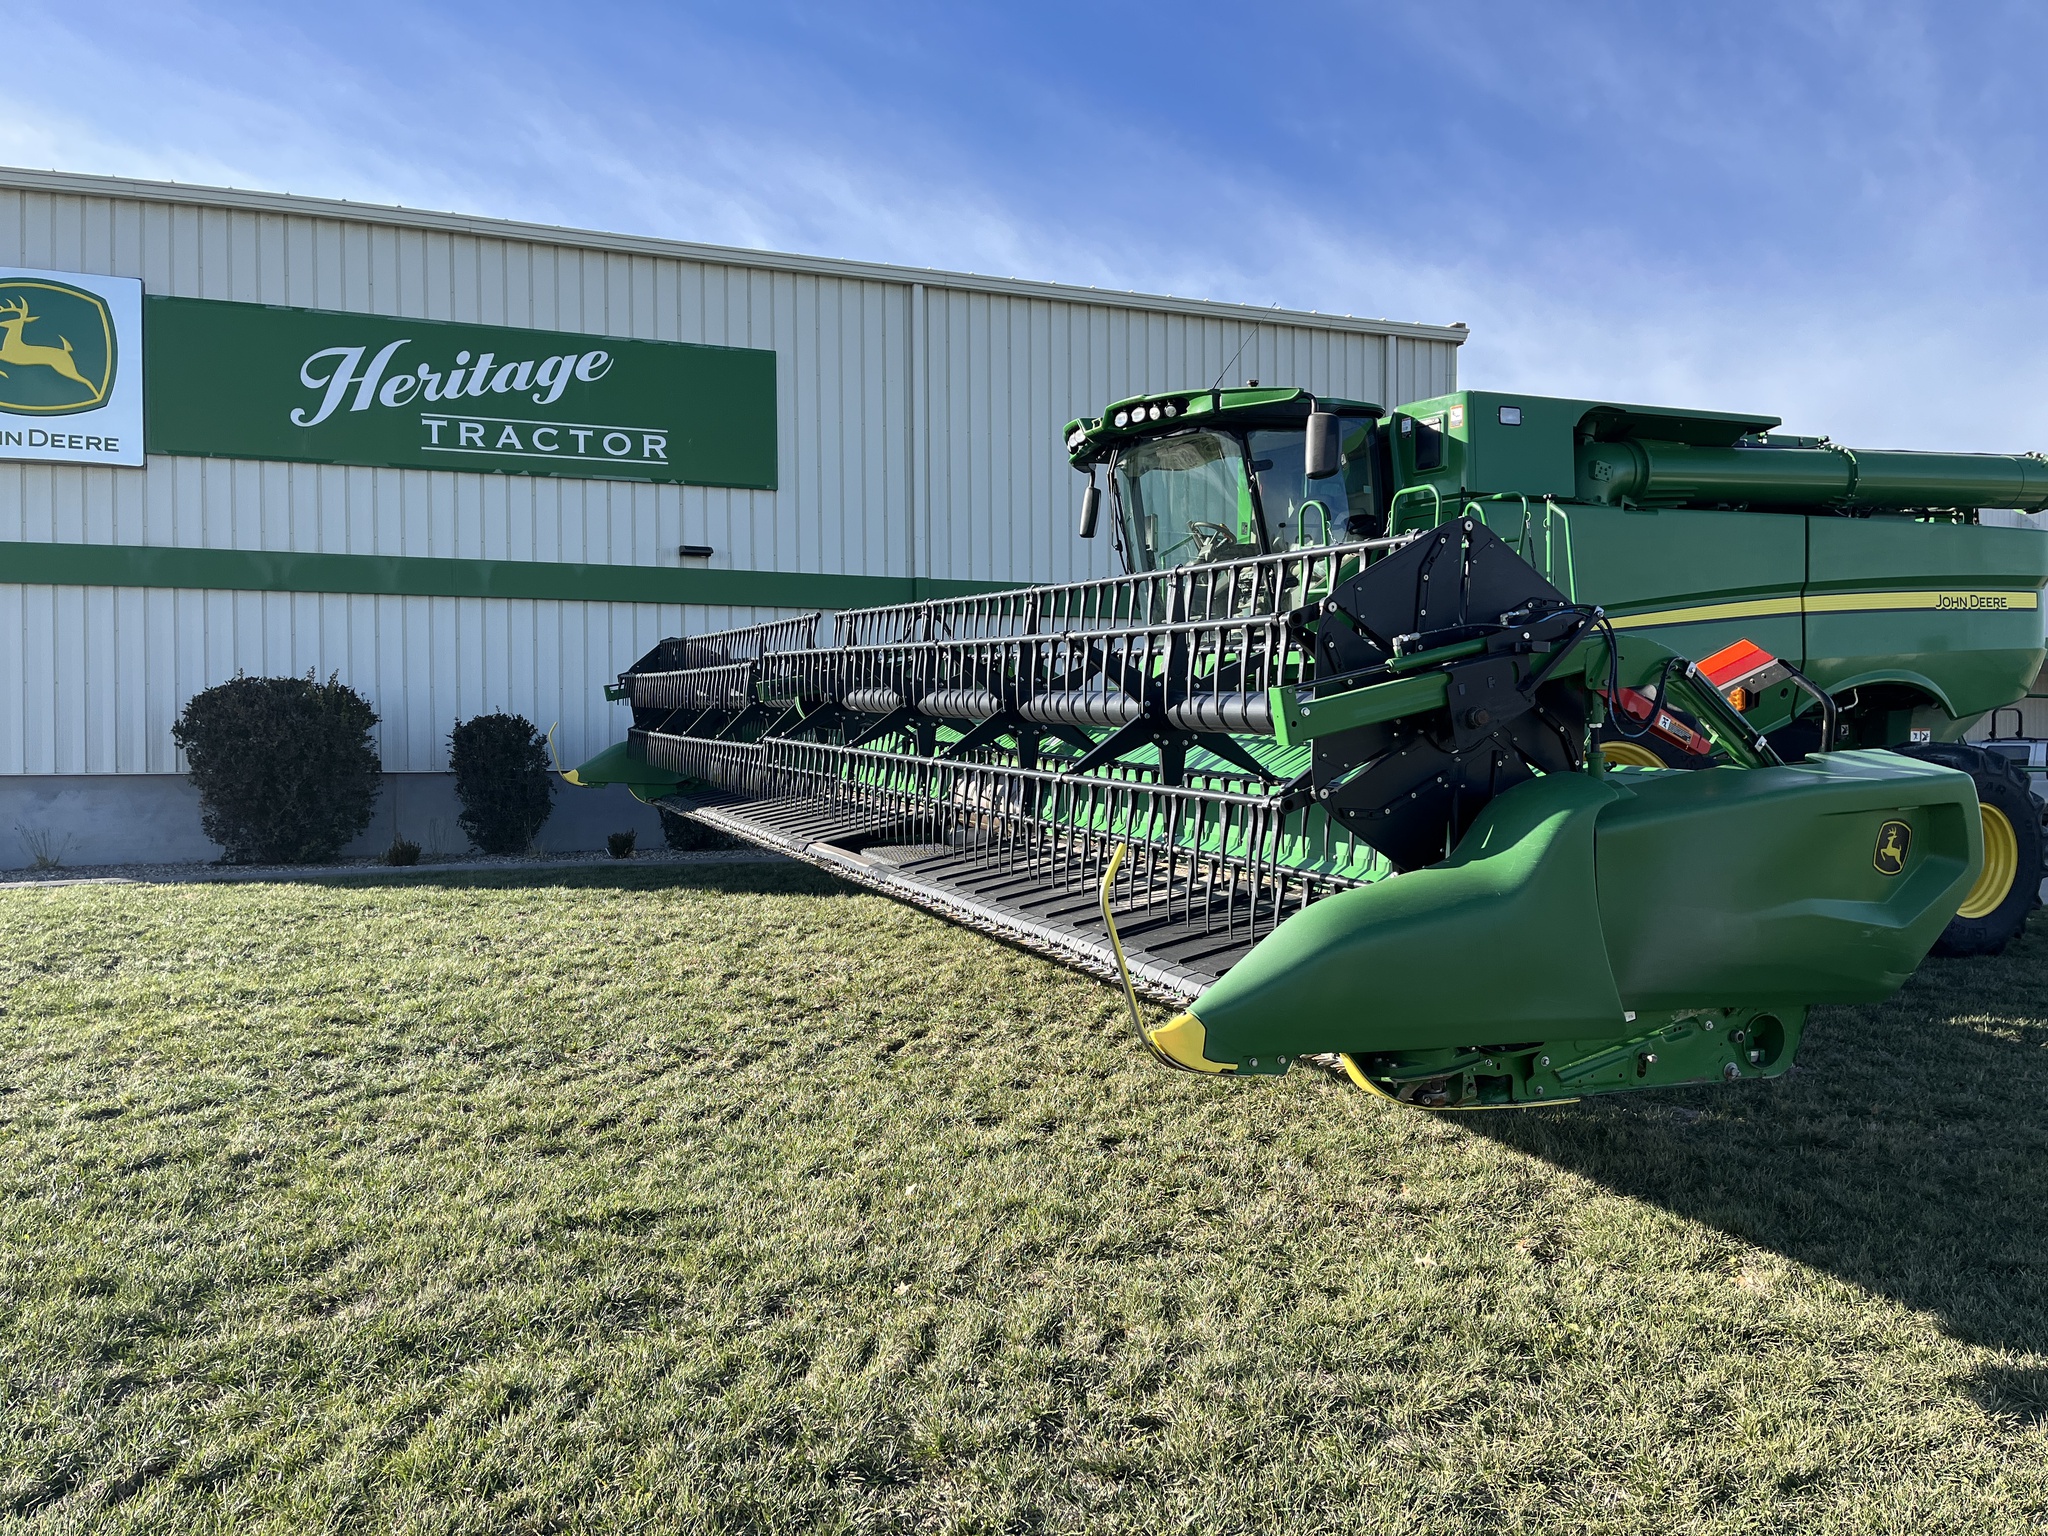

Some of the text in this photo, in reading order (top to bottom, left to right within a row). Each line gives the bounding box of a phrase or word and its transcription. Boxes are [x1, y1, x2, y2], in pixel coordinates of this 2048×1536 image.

[290, 339, 614, 427] Heritage
[28, 428, 120, 452] DEERE
[421, 418, 668, 458] TRACTOR
[1935, 594, 2008, 608] JOHN DEERE
